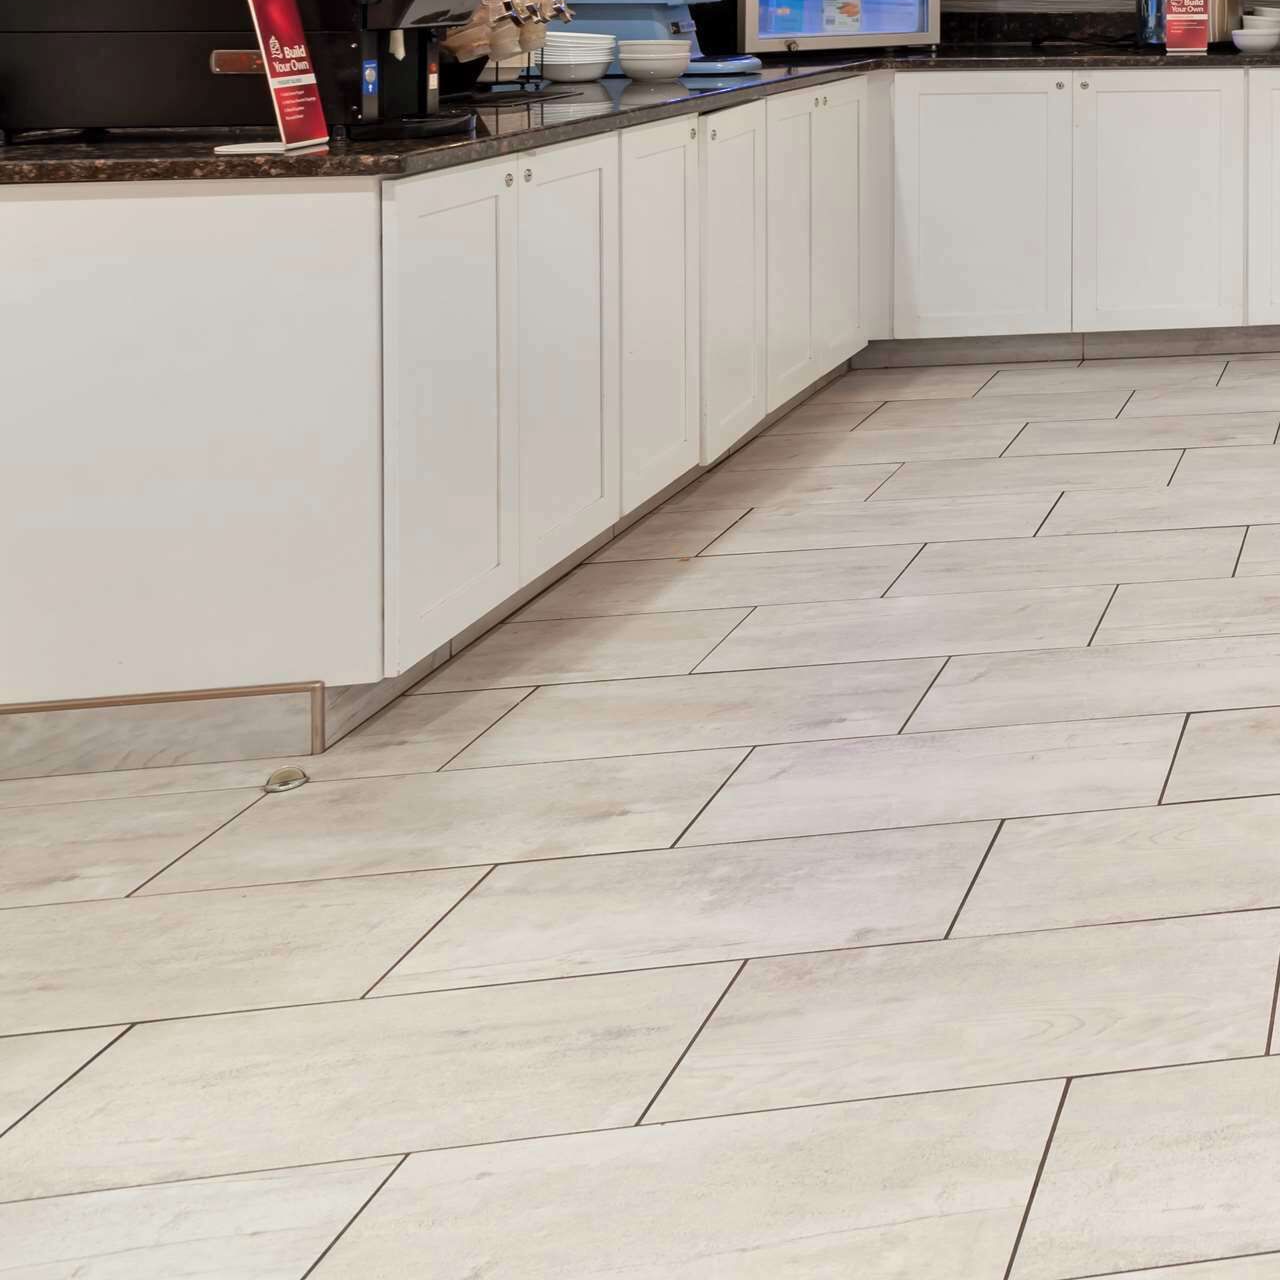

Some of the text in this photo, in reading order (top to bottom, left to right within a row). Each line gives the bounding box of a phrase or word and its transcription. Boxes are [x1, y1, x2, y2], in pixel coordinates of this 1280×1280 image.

[283, 45, 307, 59] Build
[273, 59, 310, 73] Your Own
